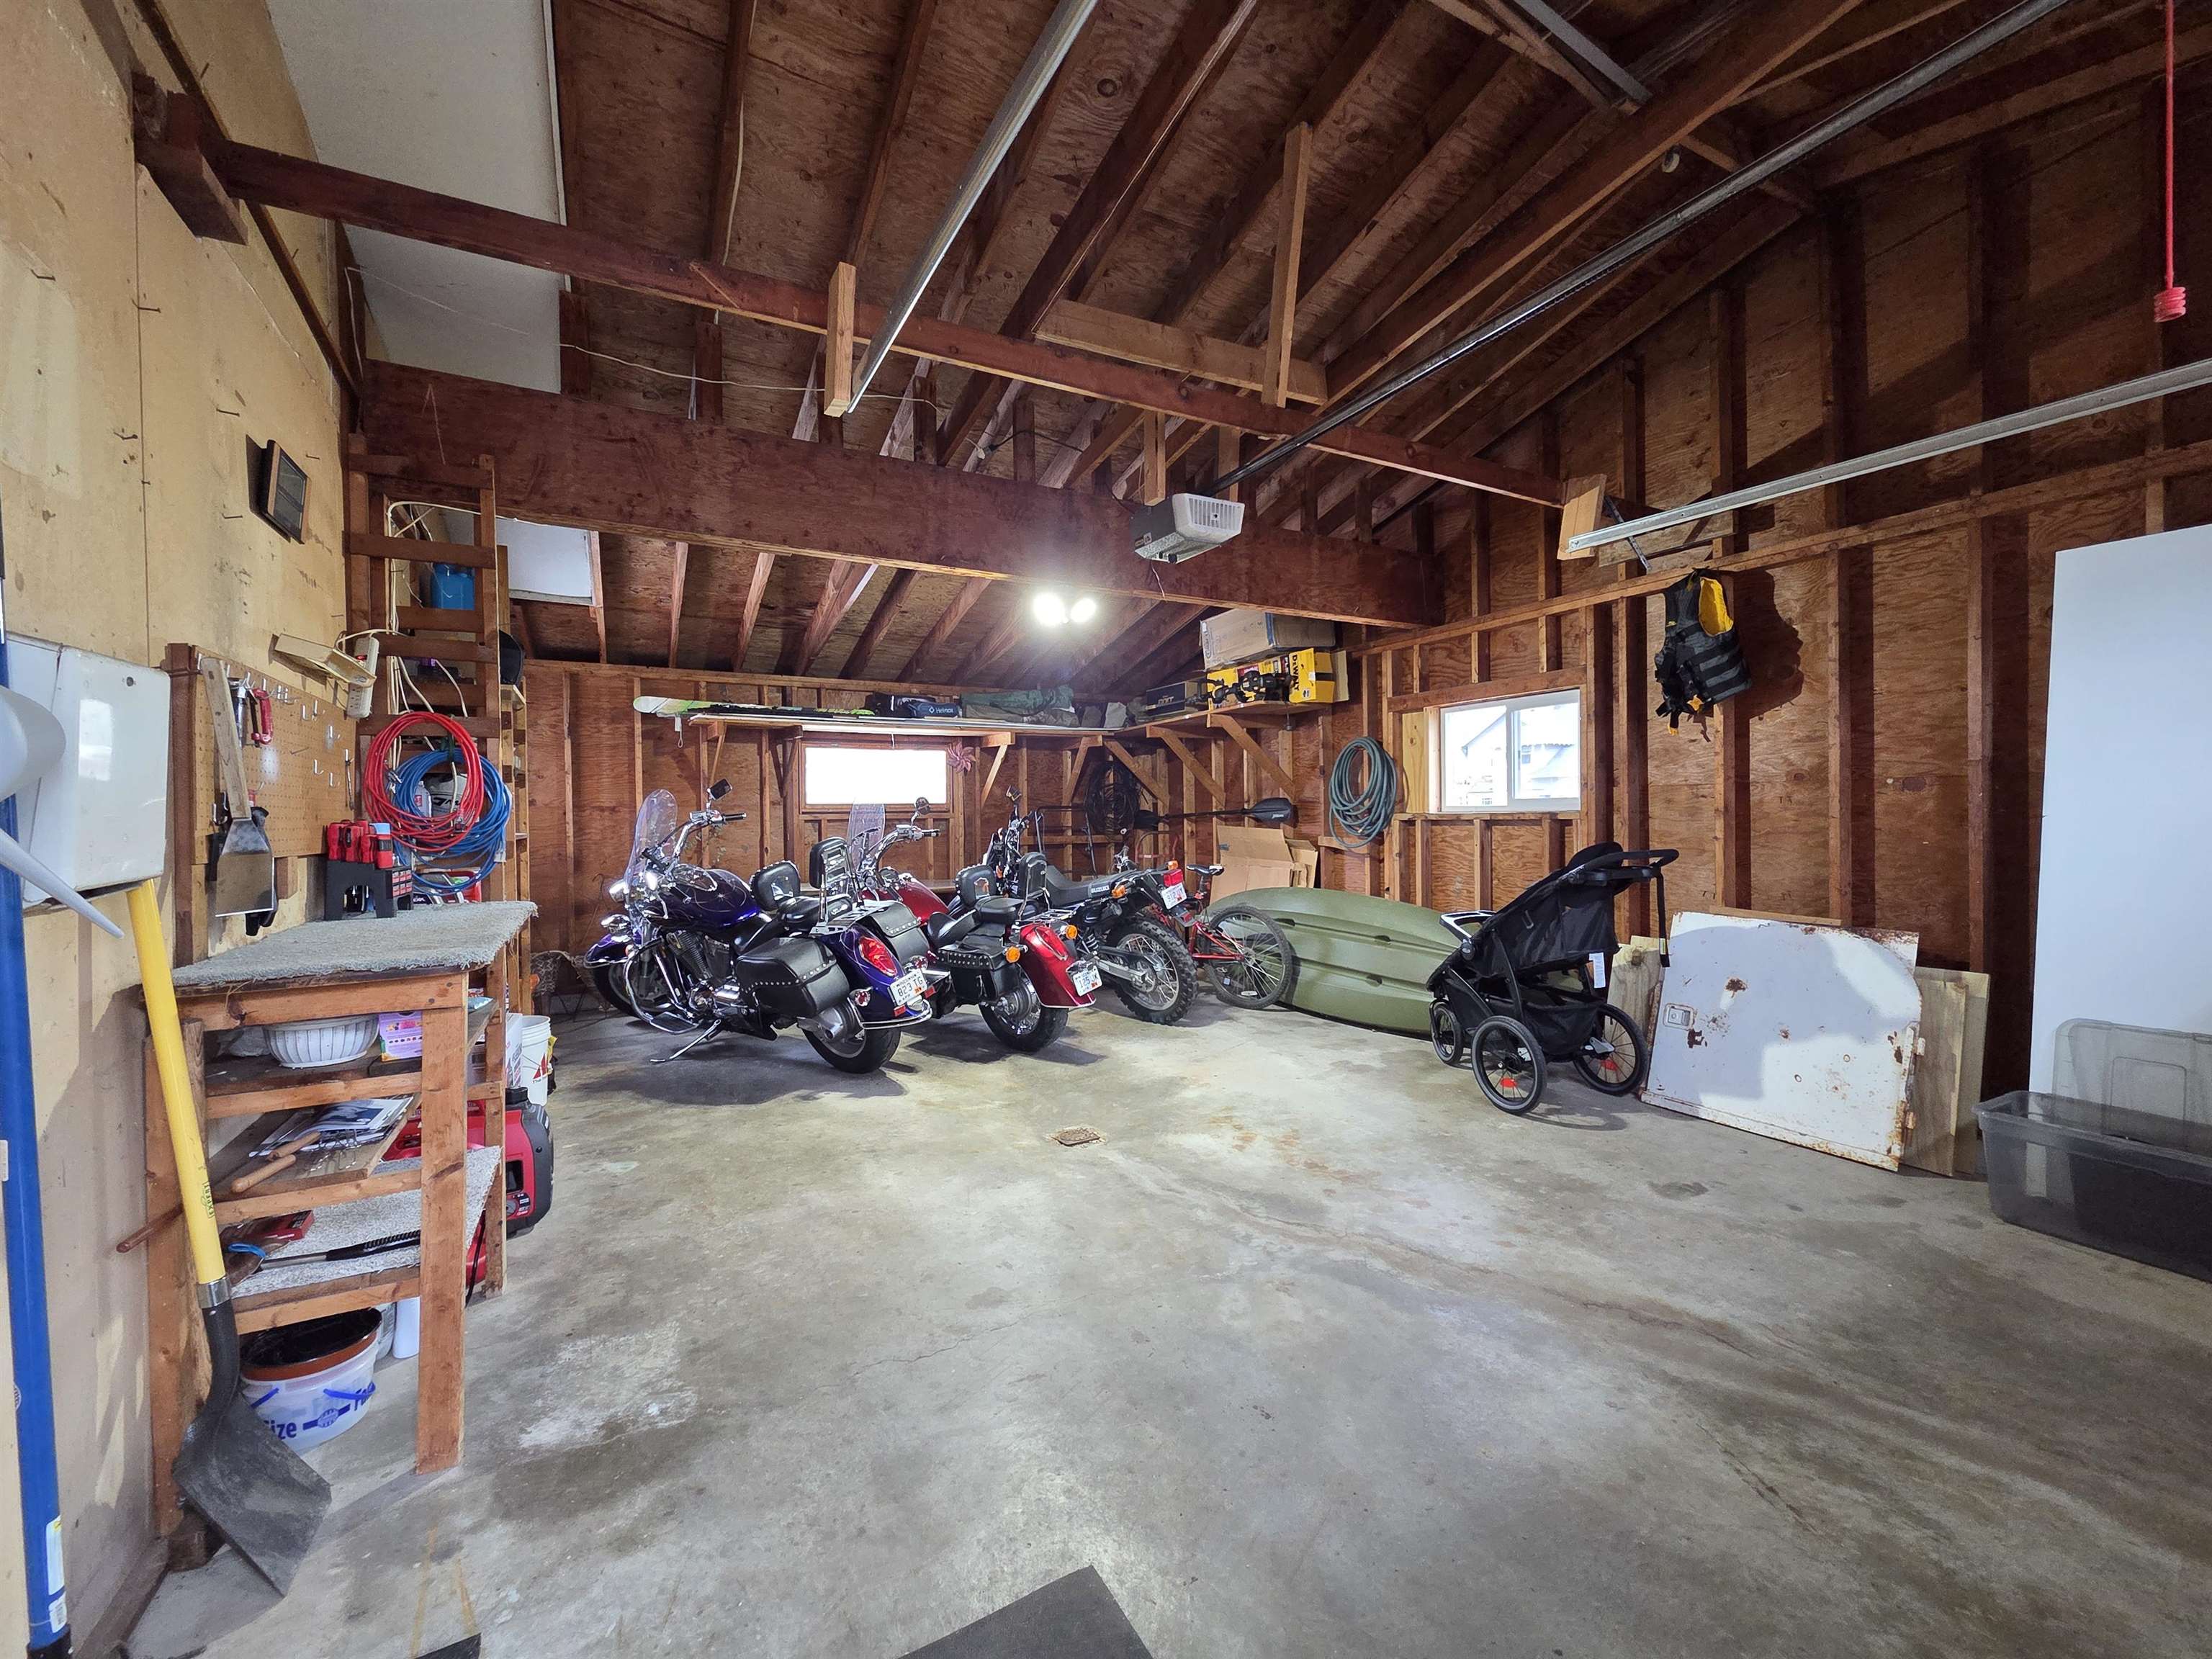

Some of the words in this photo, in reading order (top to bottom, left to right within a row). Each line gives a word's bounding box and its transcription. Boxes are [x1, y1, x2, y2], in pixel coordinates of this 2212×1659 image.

[897, 982, 912, 997] 823
[913, 976, 923, 988] TG
[264, 1419, 297, 1440] ize
